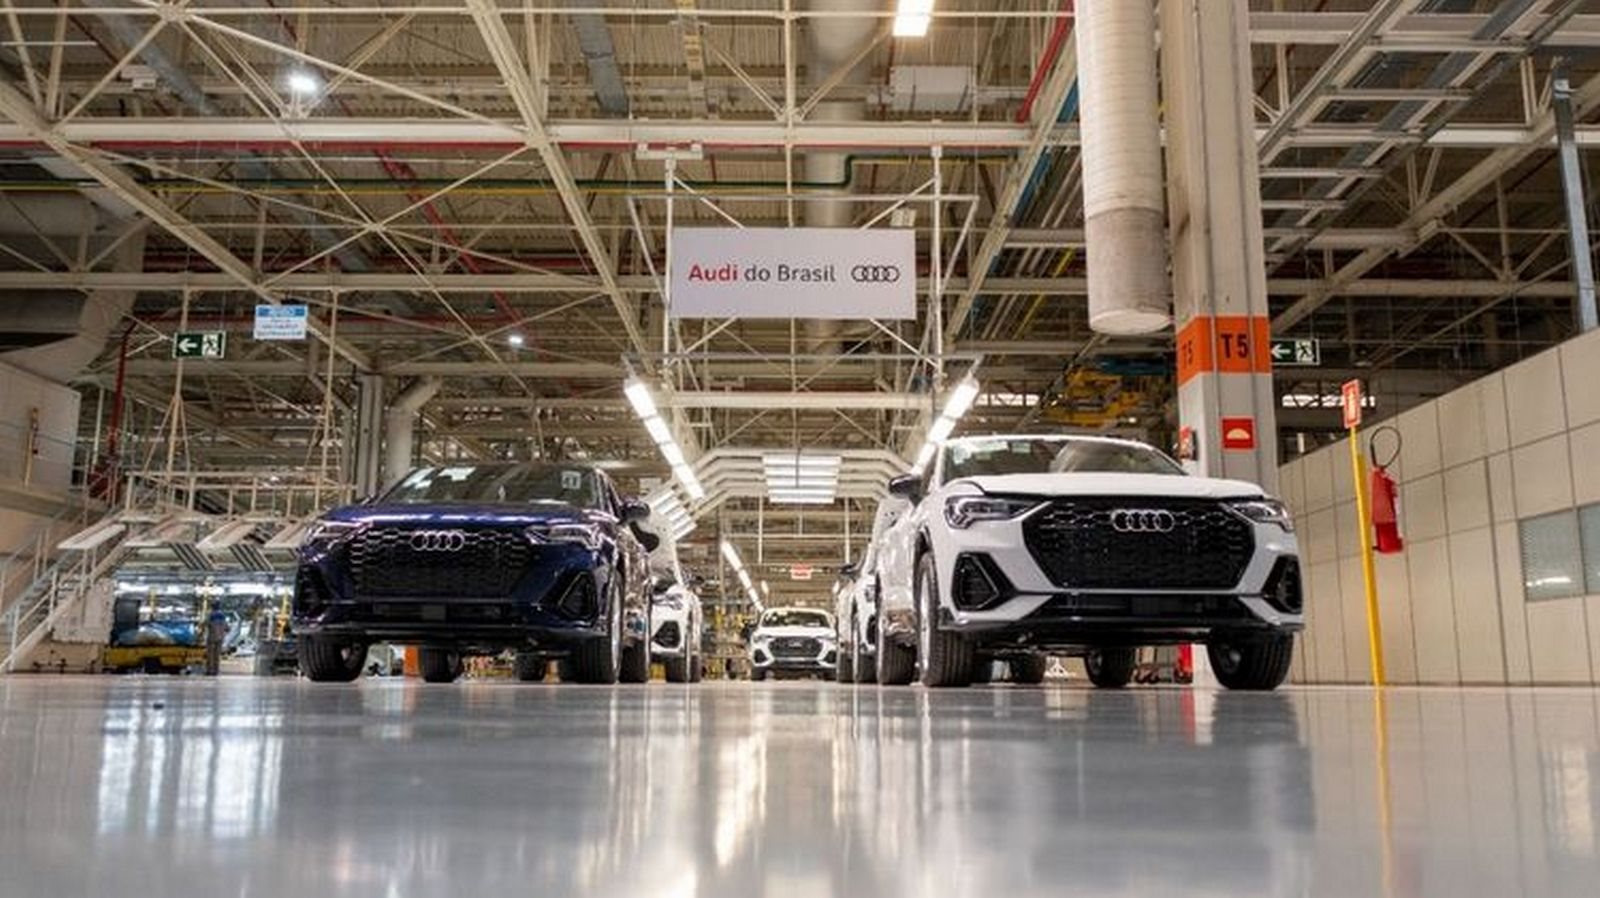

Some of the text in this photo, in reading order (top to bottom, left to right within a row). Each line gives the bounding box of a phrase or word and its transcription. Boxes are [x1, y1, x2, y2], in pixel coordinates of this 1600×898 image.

[688, 264, 836, 282] Audi do Brasil
[1220, 333, 1249, 358] T5
